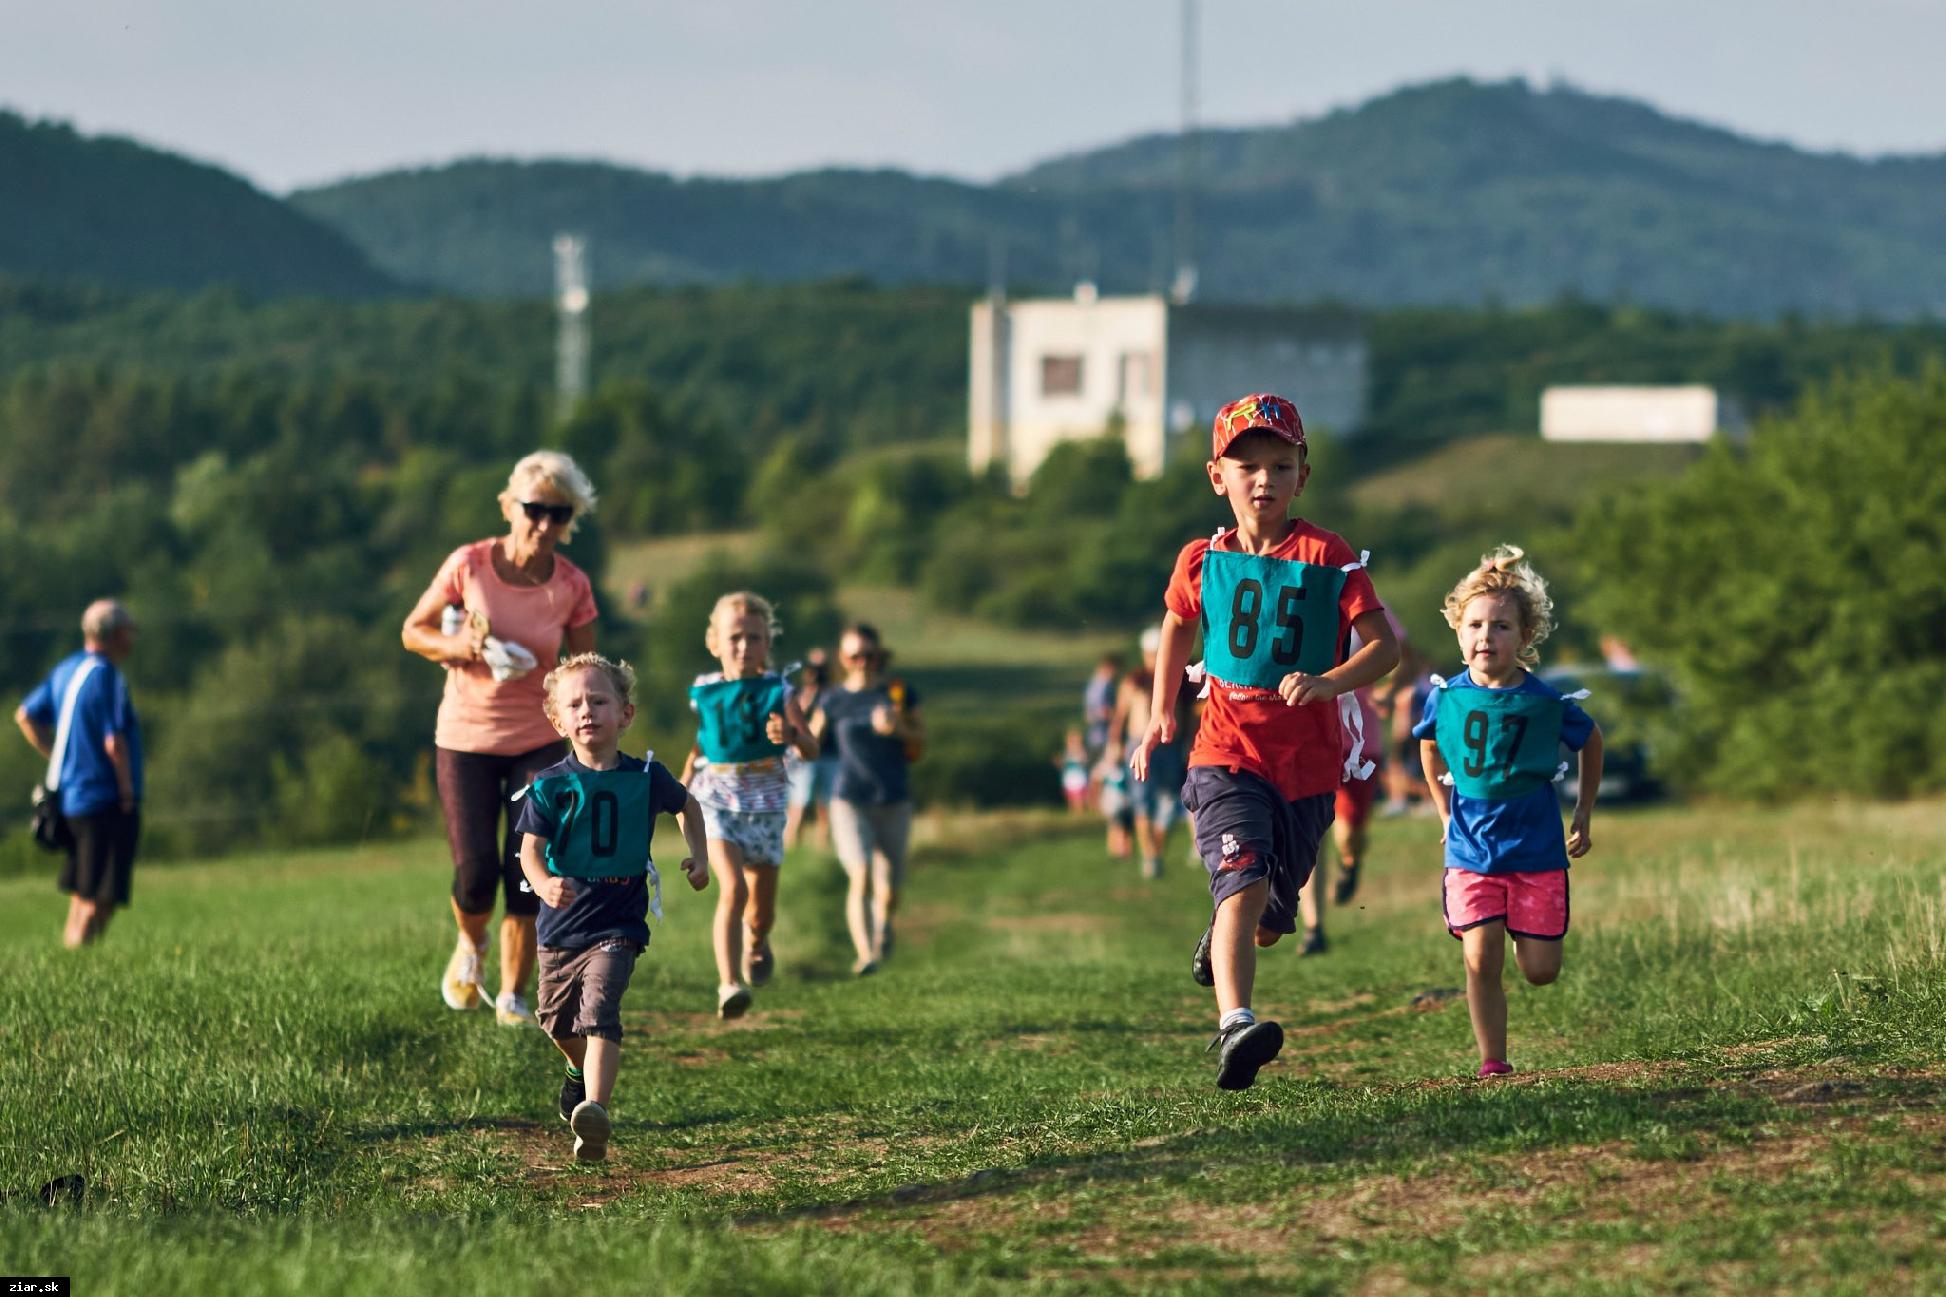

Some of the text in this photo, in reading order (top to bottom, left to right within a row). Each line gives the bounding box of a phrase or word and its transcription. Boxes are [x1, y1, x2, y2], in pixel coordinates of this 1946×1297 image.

[1229, 578, 1306, 666] 85
[1464, 710, 1528, 780] 97
[555, 790, 618, 857] 70
